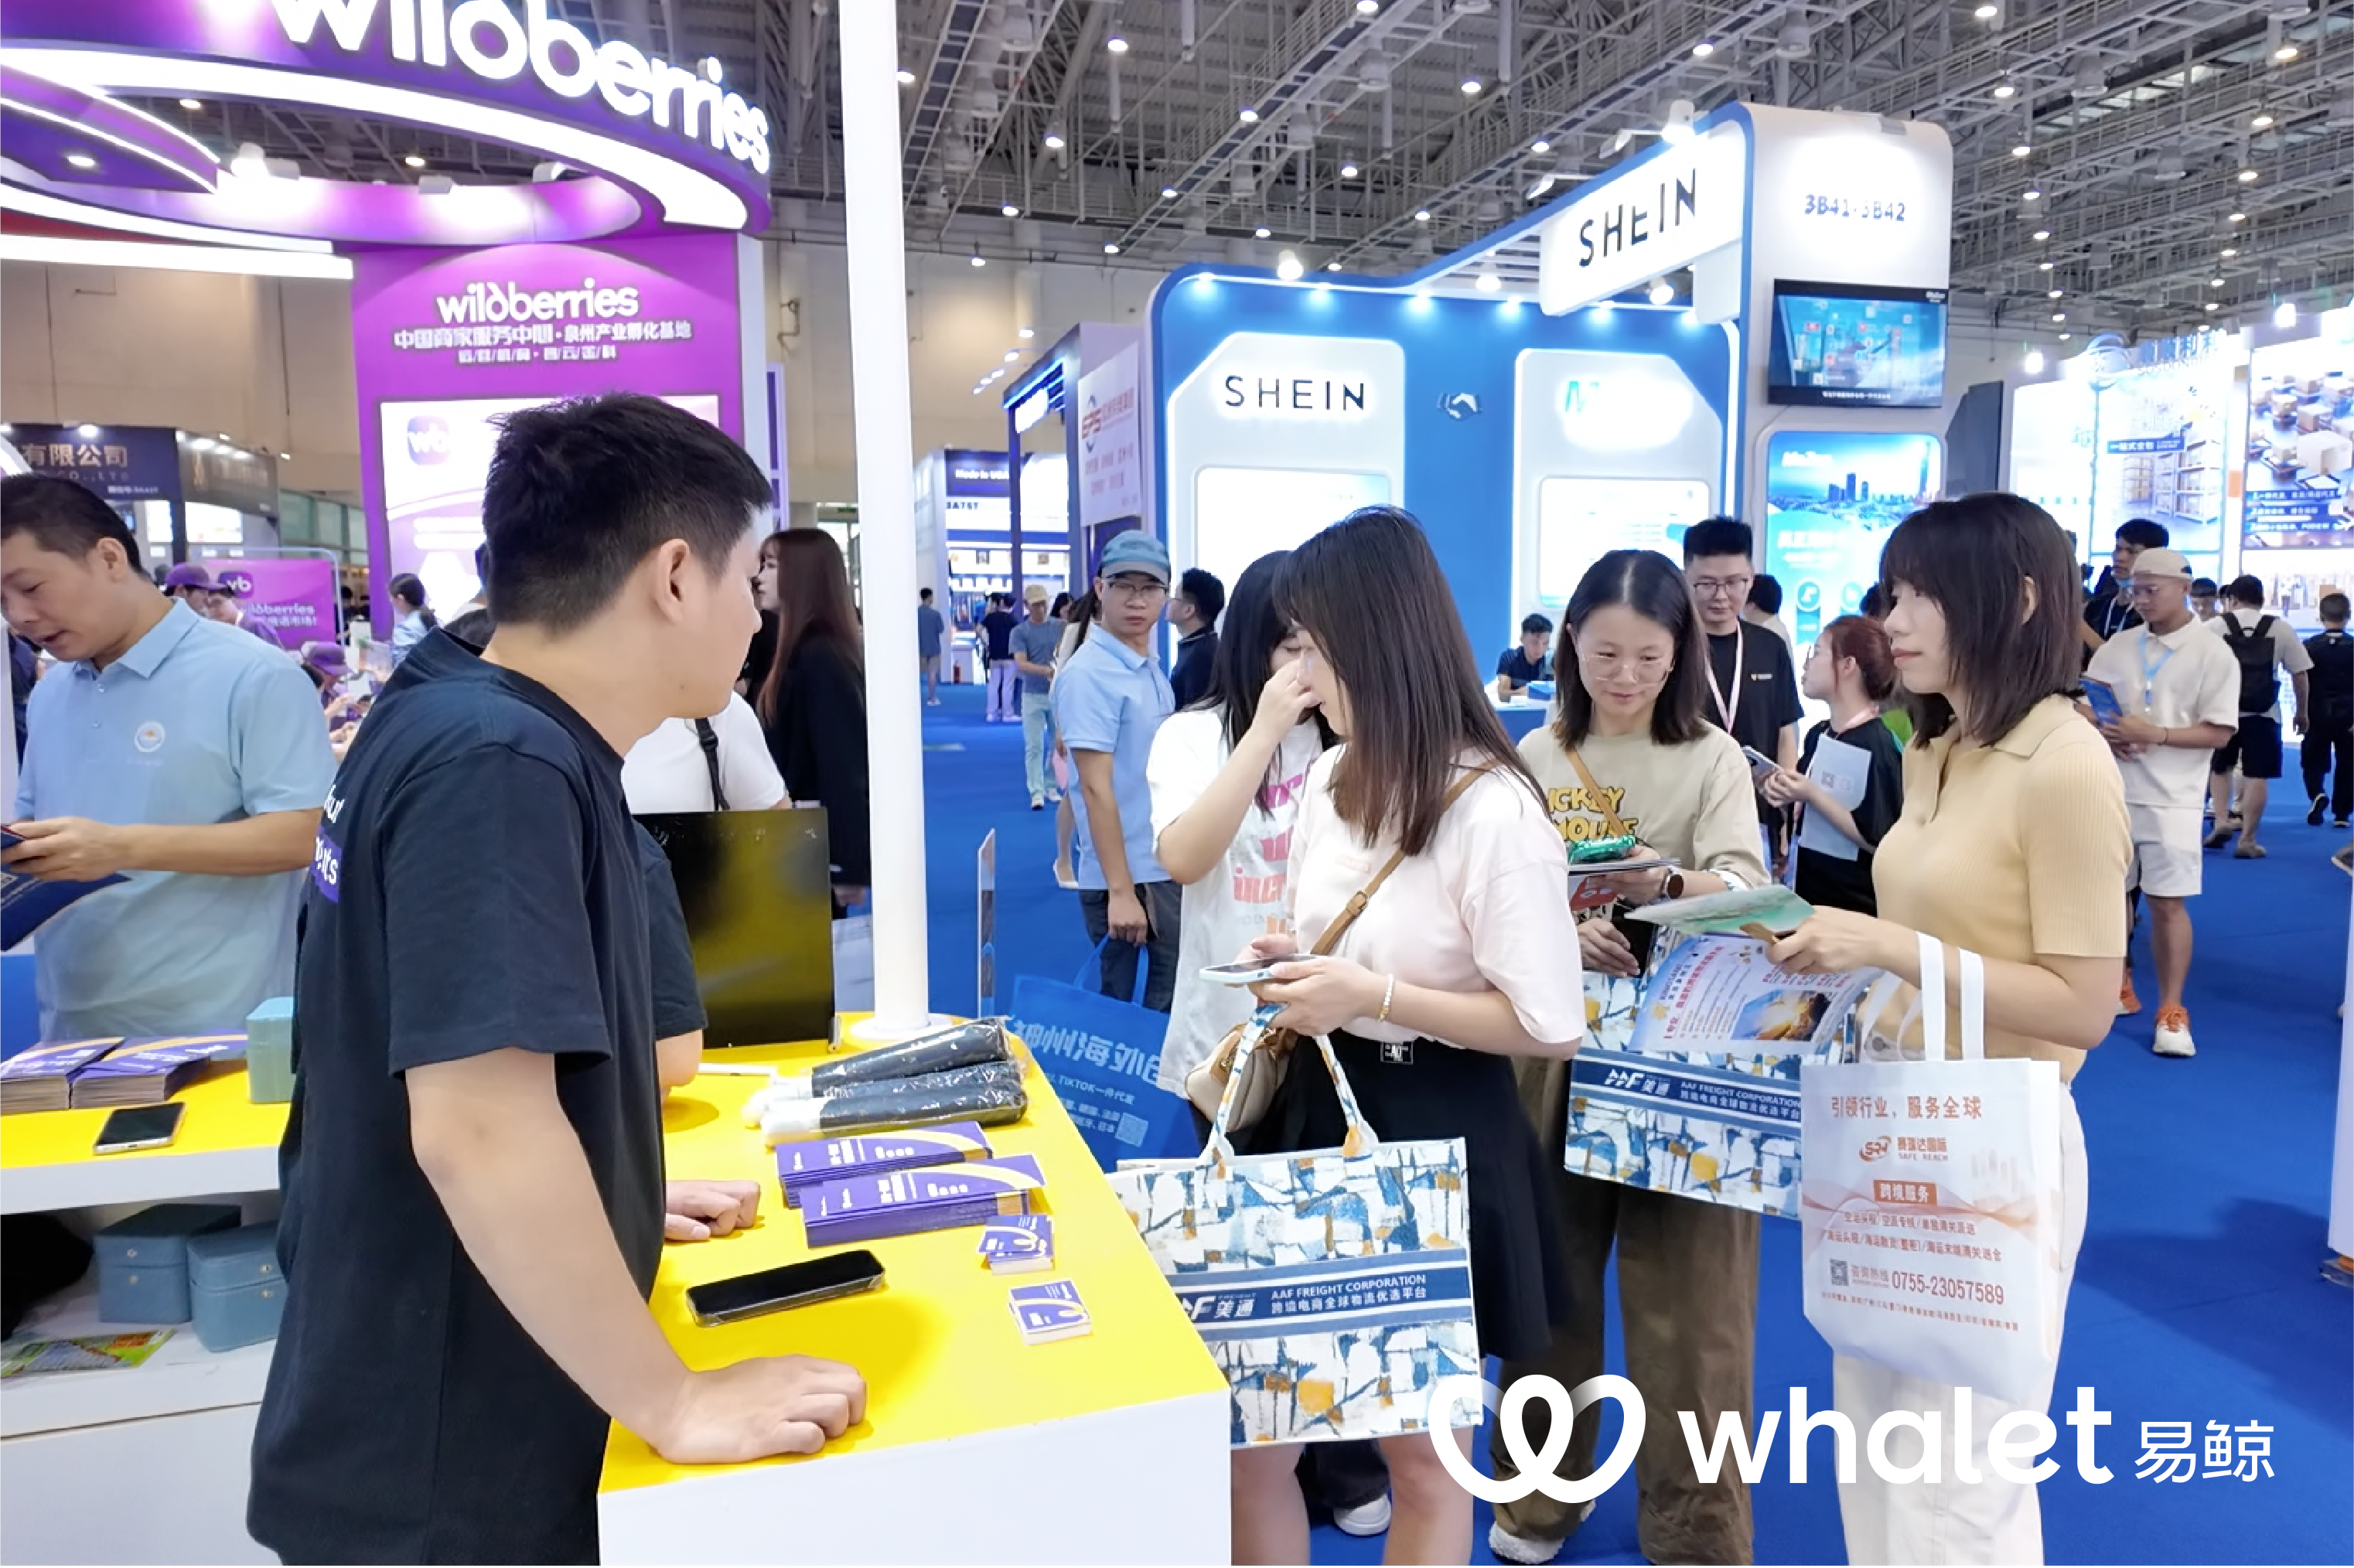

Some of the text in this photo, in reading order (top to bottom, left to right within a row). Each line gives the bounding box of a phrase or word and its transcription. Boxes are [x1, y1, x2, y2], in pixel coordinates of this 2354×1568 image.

[1578, 168, 1697, 268] SHEIN
[436, 277, 640, 323] wildberries
[1225, 375, 1366, 411] SHEIN
[21, 443, 128, 468] 有限公司
[1700, 1084, 1735, 1096] FREIGHT
[1271, 1289, 1294, 1300] AAF
[1296, 1283, 1342, 1298] FREIGHT
[1345, 1274, 1427, 1292] CORPORATION
[1892, 1270, 2005, 1306] 0755-23057589
